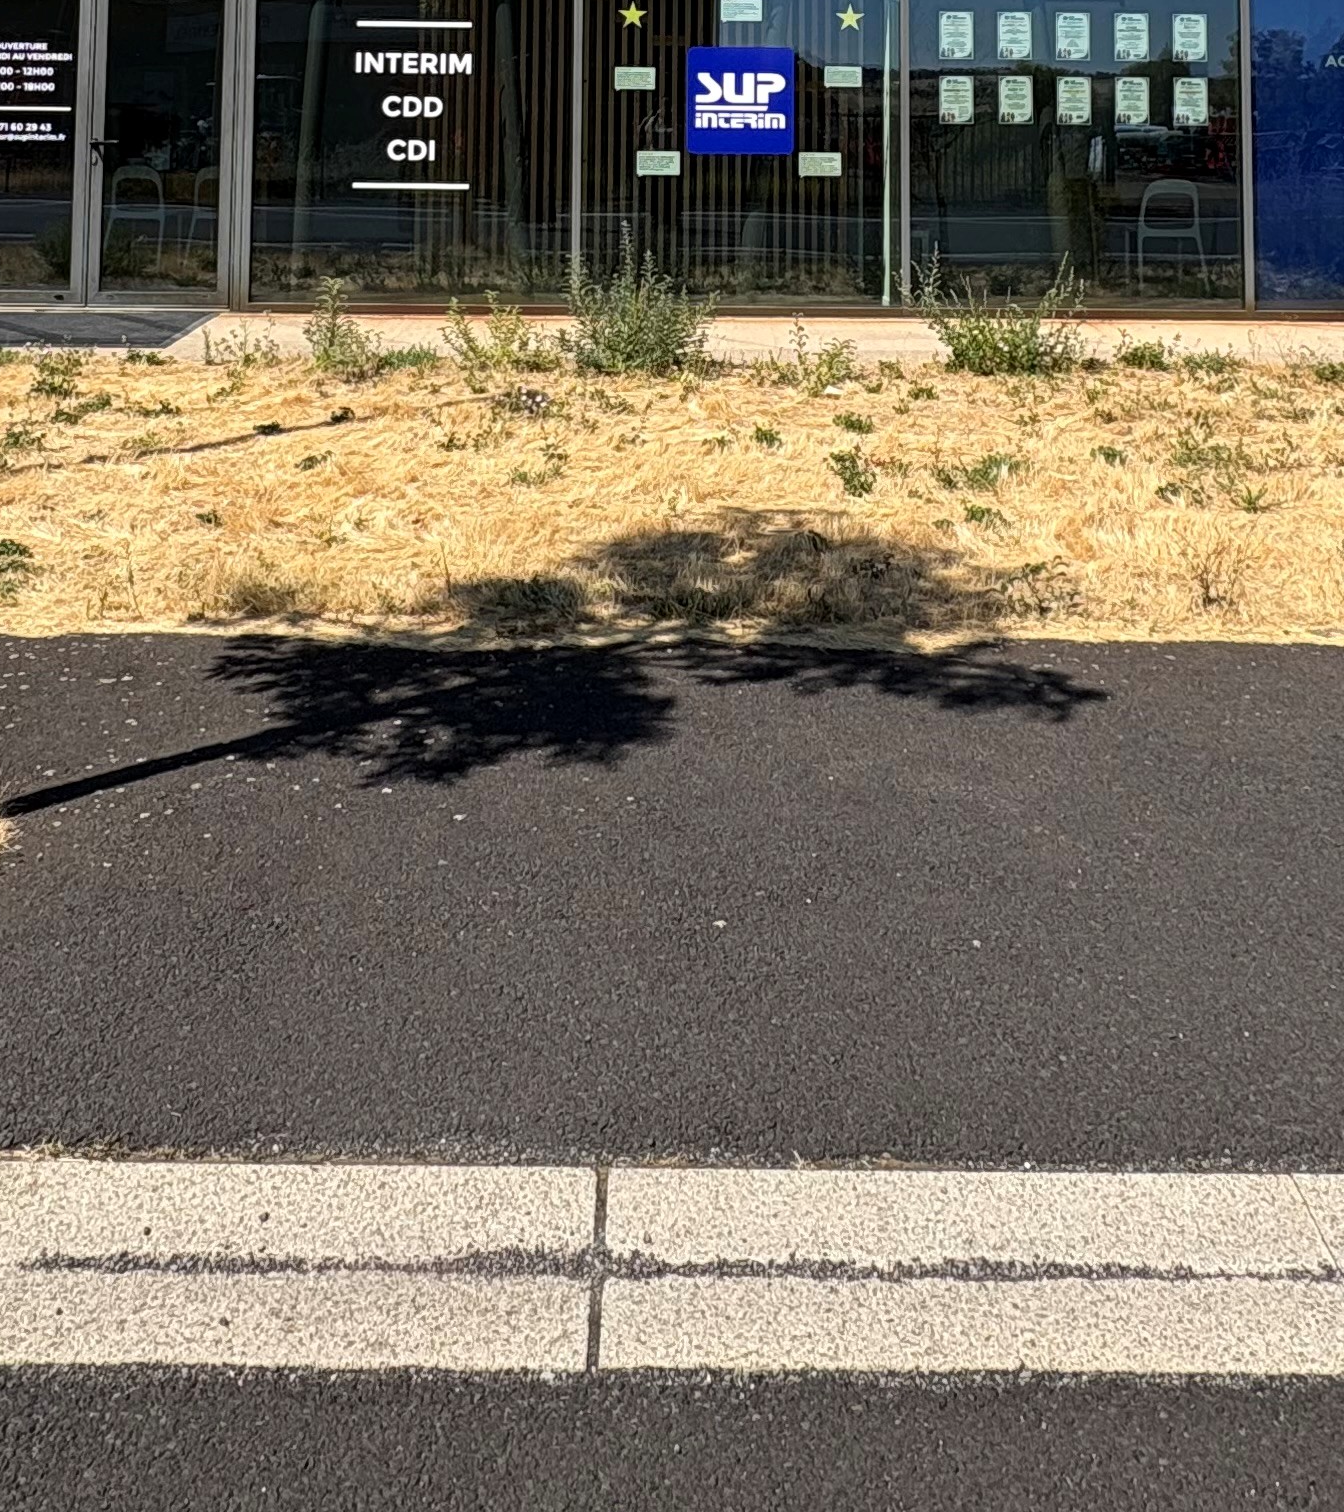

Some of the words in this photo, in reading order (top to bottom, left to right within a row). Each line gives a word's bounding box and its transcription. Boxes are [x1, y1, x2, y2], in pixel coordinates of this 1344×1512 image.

[12, 53, 25, 61] AU
[27, 53, 73, 61] VENDREDI
[355, 52, 473, 75] INTERIM
[22, 67, 54, 76] 12H00
[695, 72, 786, 104] SUP
[382, 95, 443, 118] CDD
[387, 139, 436, 161] CDI
